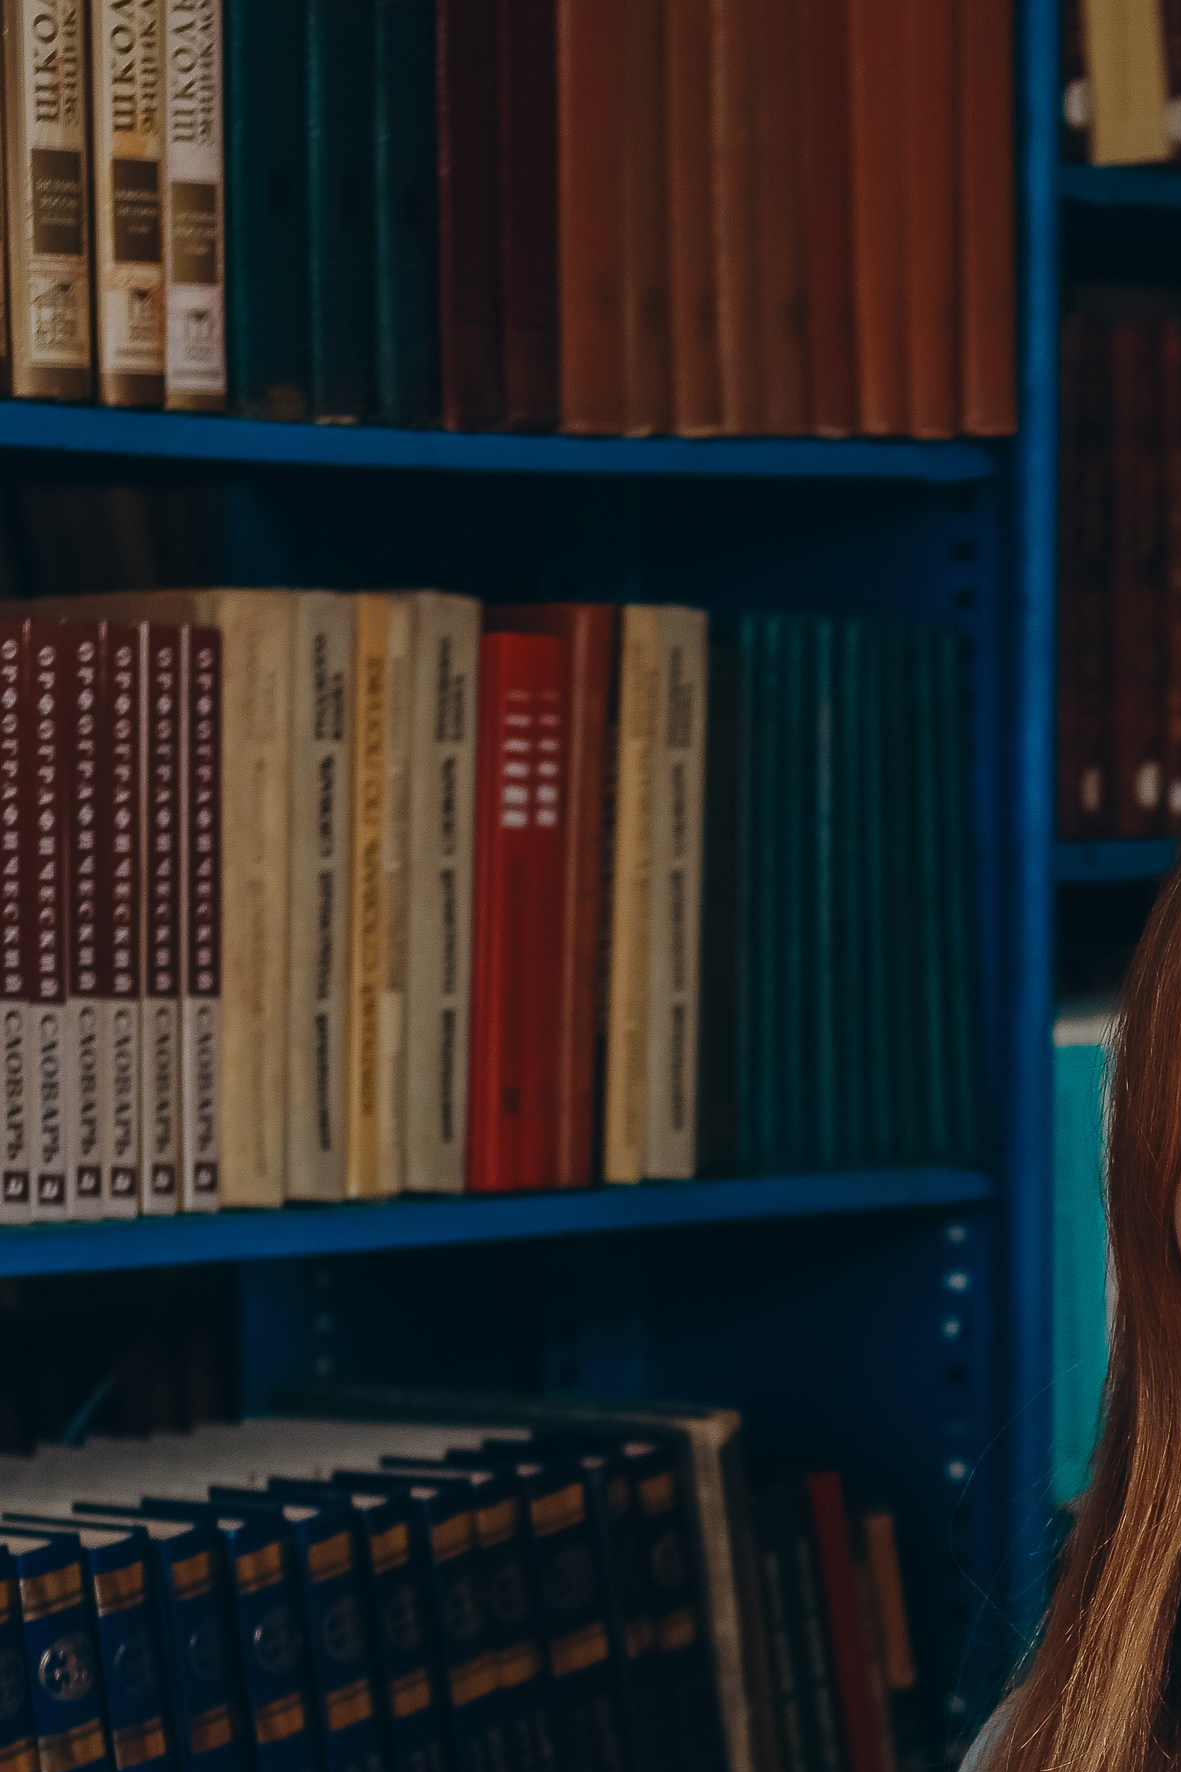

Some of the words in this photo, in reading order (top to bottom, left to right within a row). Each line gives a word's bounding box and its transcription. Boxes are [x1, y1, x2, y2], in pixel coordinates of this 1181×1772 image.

[32, 0, 60, 123] ШКО
[5, 1008, 24, 1162] СЛОВАРЬ
[40, 1012, 60, 1164] СЛОВАРЬ
[79, 1005, 98, 1156] СЛОВАРЬ
[113, 1008, 132, 1158] СЛОВАРЬ
